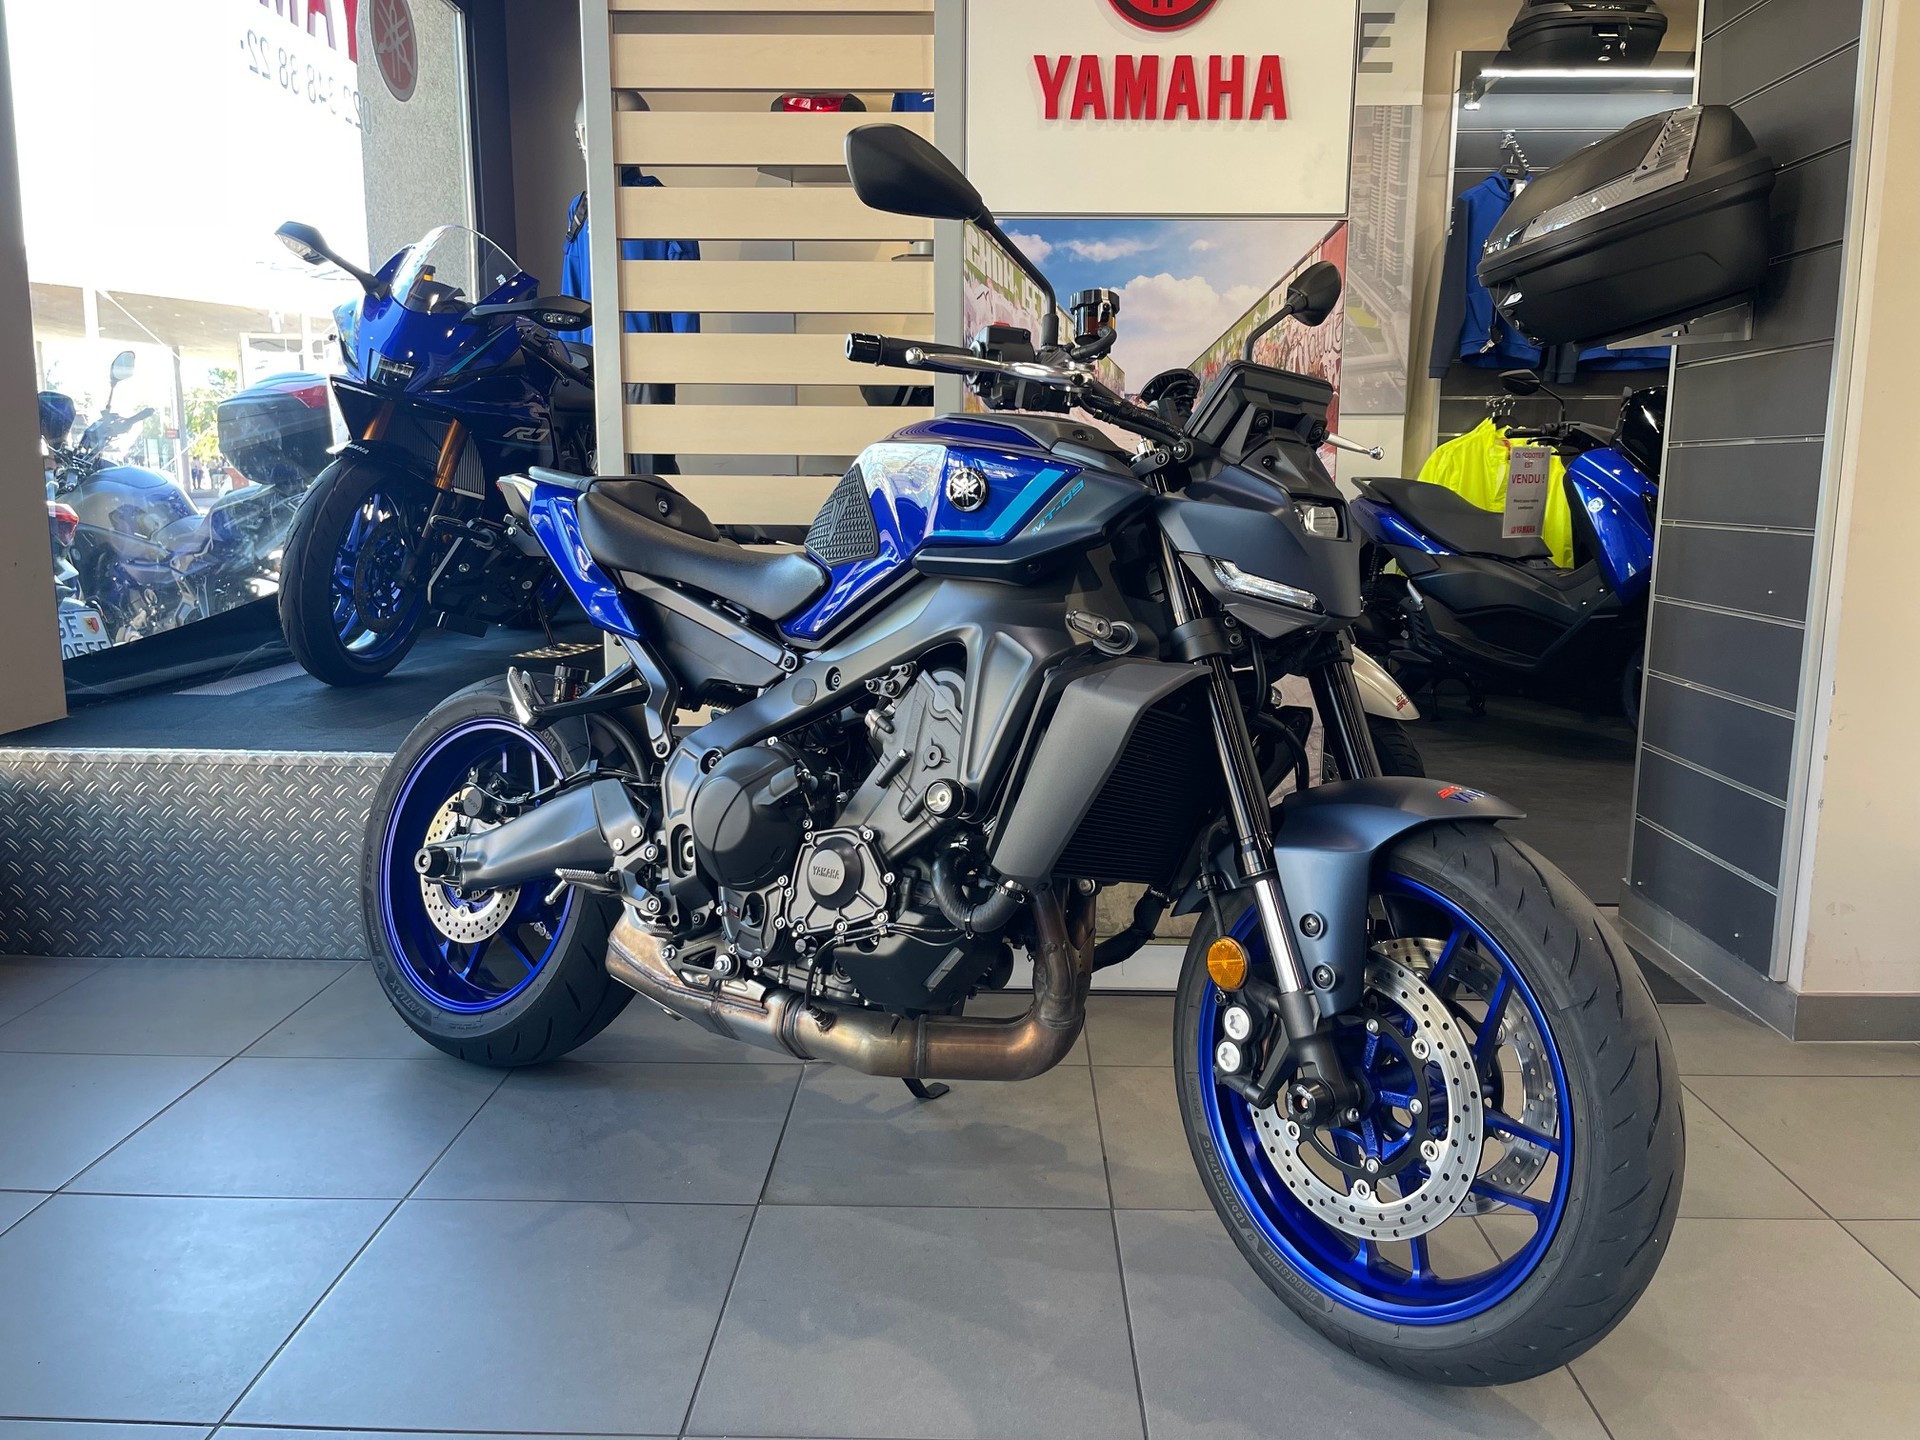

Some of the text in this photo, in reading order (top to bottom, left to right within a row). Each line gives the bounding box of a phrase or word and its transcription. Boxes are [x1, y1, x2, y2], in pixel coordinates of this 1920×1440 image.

[1033, 54, 1287, 121] YAMAHA
[1511, 474, 1540, 484] VENDU
[1031, 479, 1085, 536] MT-09
[812, 865, 840, 880] YAMAHA
